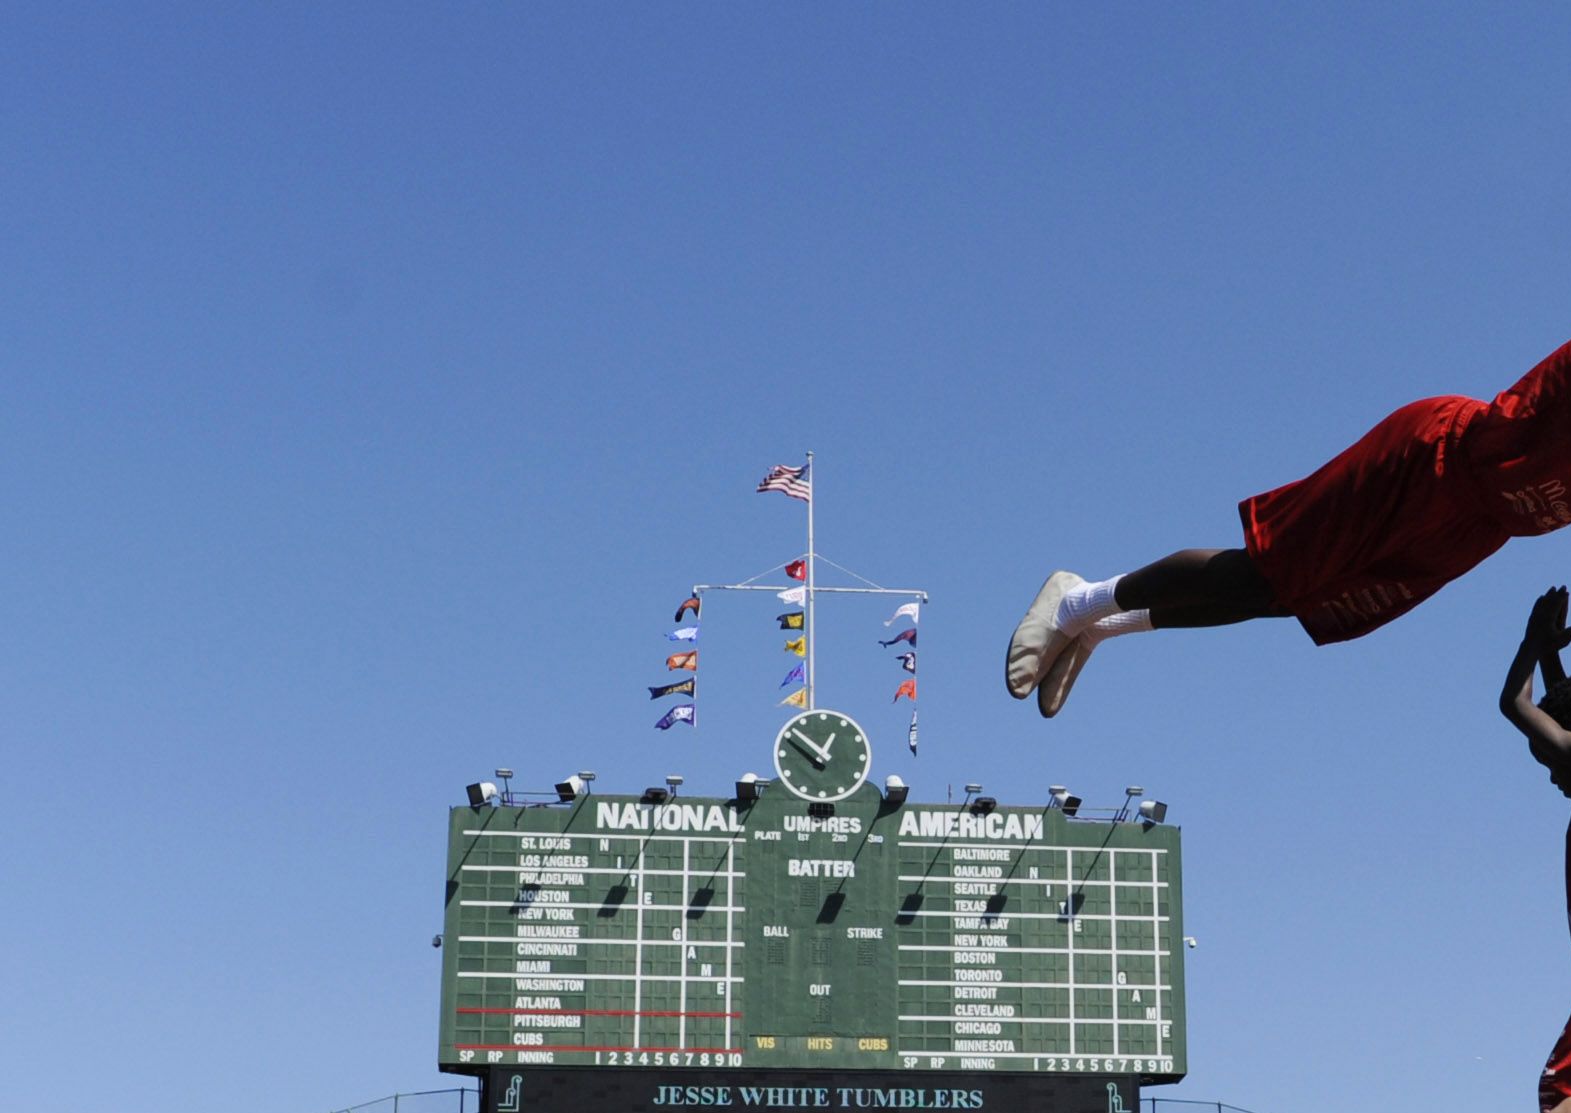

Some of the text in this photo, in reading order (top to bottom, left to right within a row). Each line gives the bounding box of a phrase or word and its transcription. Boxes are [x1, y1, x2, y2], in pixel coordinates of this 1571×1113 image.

[597, 801, 745, 832] NATIONAL
[783, 816, 862, 834] UMPIRES
[899, 811, 1044, 839] AMERICAN
[754, 831, 782, 841] PLATE
[521, 837, 571, 851] ST. LOUIS
[520, 854, 589, 868] LOS ANGELES
[953, 849, 1011, 862] BALTIMORE
[788, 860, 856, 878] BATTER
[954, 866, 1003, 878] OAKLAND
[519, 872, 585, 886] PHILADELPHIA
[954, 883, 997, 895] SEATTLE
[519, 890, 570, 903] HOUSTON
[954, 900, 988, 912] TEXAS
[518, 908, 575, 921] NEW YORK
[954, 918, 1010, 931] TAMPA BAY
[518, 926, 580, 939] MILWAUKEE
[763, 926, 789, 938] BALL
[847, 928, 884, 940] STRIKE
[954, 935, 1008, 947] NEW YORK
[517, 943, 578, 957] CINCINNATI
[954, 952, 996, 964] BOSTON
[516, 961, 550, 973] MIAMI
[954, 969, 1003, 981] TORONTO
[516, 978, 584, 992] WASHINGTON
[809, 984, 831, 996] OUT
[955, 987, 998, 999] DETROIT
[515, 997, 561, 1010] ATLANTA
[954, 1004, 1015, 1017] CLEVELAND
[514, 1014, 581, 1028] PITTSBURGH
[955, 1022, 1002, 1035] CHICAGO
[513, 1033, 543, 1046] CUBS
[756, 1037, 888, 1051] VIS HITS CUBS
[955, 1039, 1015, 1053] MINNESOTA
[459, 1050, 475, 1062] SP
[488, 1051, 503, 1063] RP
[517, 1051, 554, 1064] INNING
[608, 1052, 618, 1065] 2
[624, 1053, 634, 1065] 3
[638, 1053, 649, 1066] 4
[654, 1053, 664, 1066] 5
[669, 1053, 679, 1066] 6
[685, 1053, 694, 1066] 7
[700, 1054, 710, 1066] 8
[715, 1054, 725, 1067] 9
[728, 1054, 742, 1067] 10
[904, 1057, 918, 1069] SP
[930, 1057, 945, 1069] RP
[960, 1057, 995, 1070] INNING
[1047, 1058, 1056, 1071] 2
[1061, 1059, 1070, 1071] 3
[1075, 1059, 1085, 1071] 4
[1090, 1059, 1099, 1071] 5
[1104, 1059, 1114, 1072] 6
[1118, 1059, 1128, 1072] 7
[1133, 1059, 1142, 1072] 8
[1148, 1059, 1157, 1072] 9
[1160, 1059, 1173, 1072] 10
[653, 1085, 983, 1109] JESSE WHITE TUMBLERS
